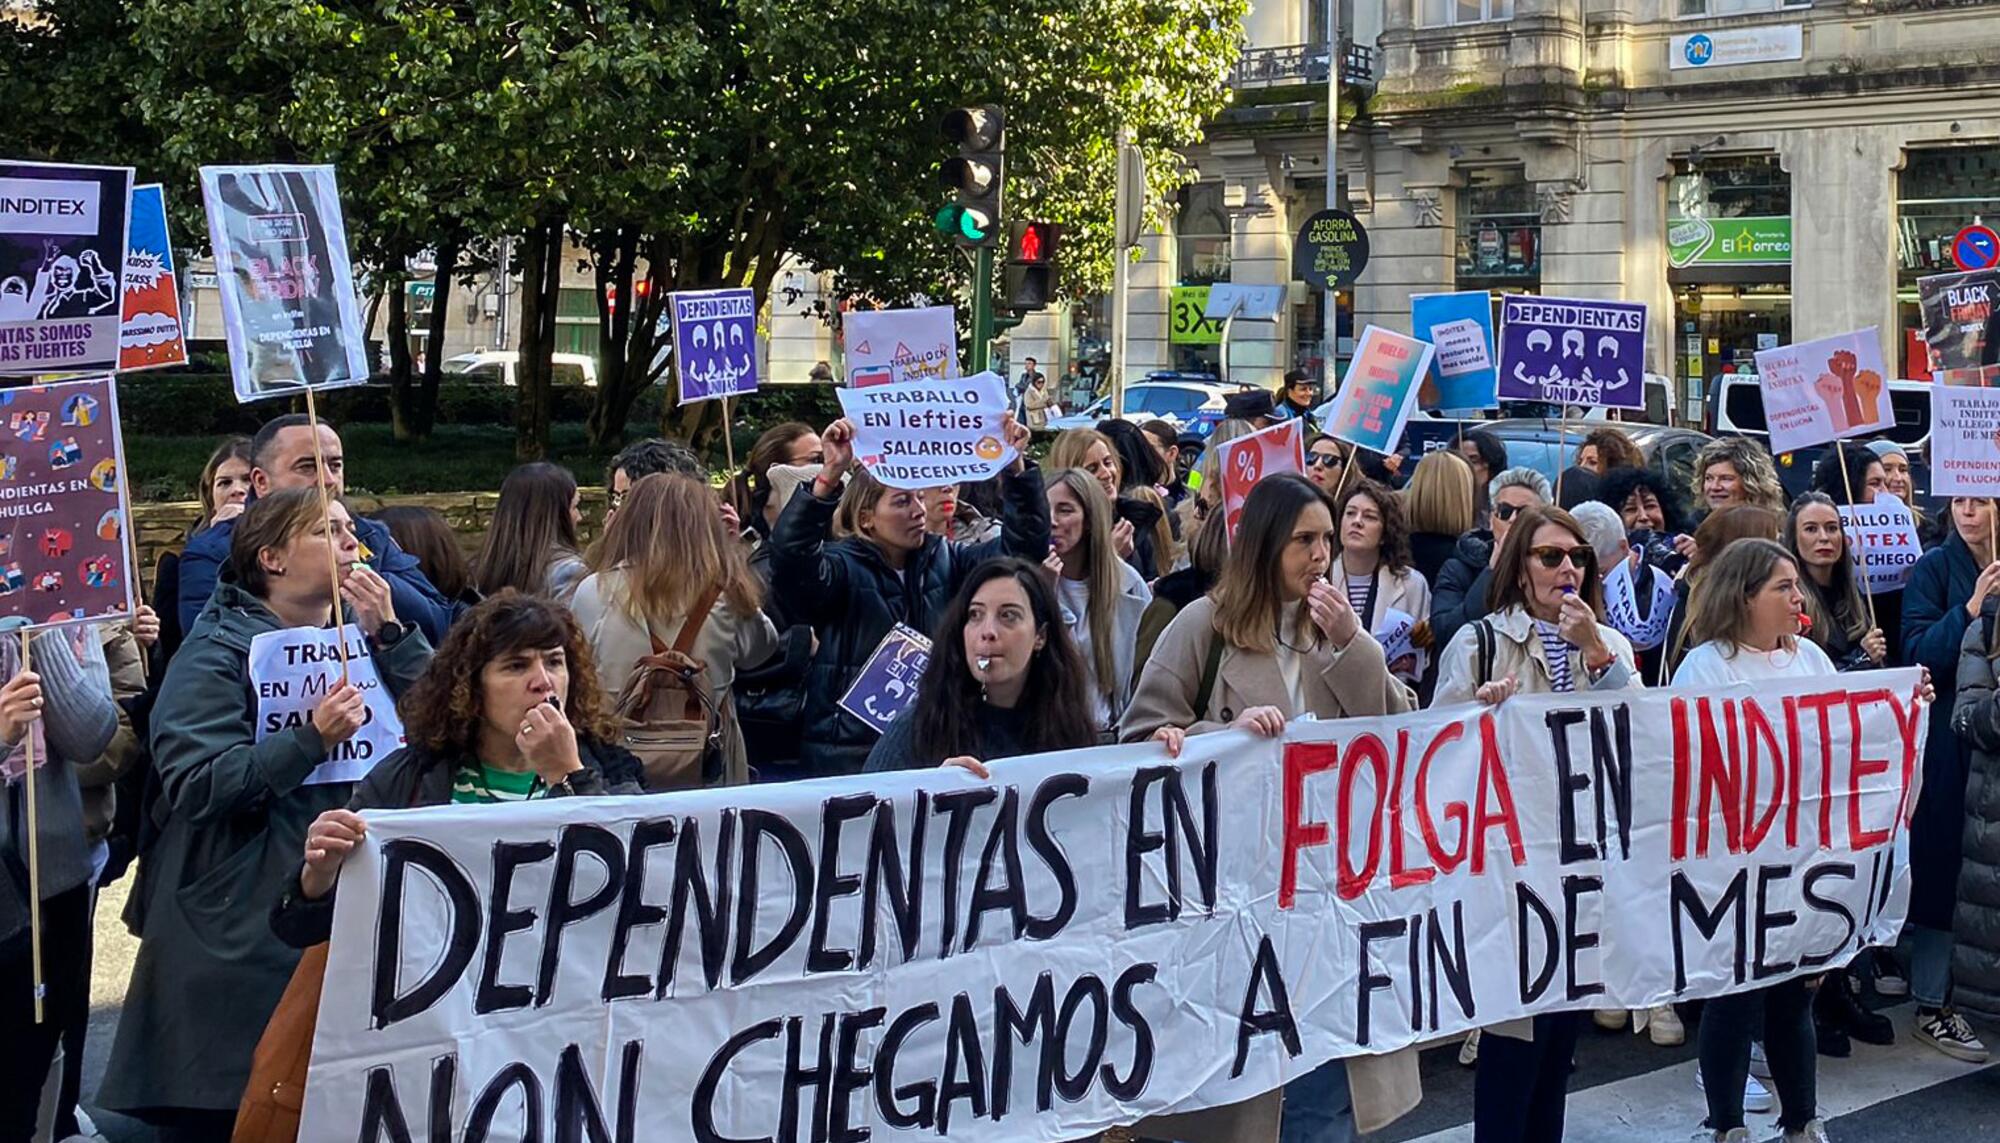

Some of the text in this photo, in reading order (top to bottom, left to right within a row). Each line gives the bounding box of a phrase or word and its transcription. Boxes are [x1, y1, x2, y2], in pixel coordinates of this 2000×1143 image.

[0, 198, 85, 215] INDITEX
[1313, 219, 1352, 230] AFORRA
[1308, 230, 1357, 243] GASOLINA
[1722, 239, 1734, 252] El
[248, 254, 320, 279] BLACK
[1947, 285, 1990, 306] BLACK
[681, 299, 752, 319] DEPENDIENTAS
[1509, 305, 1640, 329] DEPENDIENTAS
[1950, 302, 1991, 322] FRIDAY
[40, 323, 92, 341] SOMOS
[25, 341, 86, 360] FUERTES
[865, 390, 979, 404] TRABALLO
[1543, 387, 1600, 402] UNIDAS
[1951, 399, 1999, 408] TRABAJO
[863, 409, 983, 429] EN lefties
[1958, 419, 1993, 428] LLEGO
[1963, 430, 1977, 439] DE
[883, 440, 973, 456] SALARIOS
[875, 462, 991, 479] INDECENTES
[70, 479, 88, 491] EN
[1956, 475, 1969, 483] EN
[1893, 514, 1910, 526] EN
[1865, 553, 1916, 566] CHEGO
[260, 681, 289, 698] EN
[370, 773, 1090, 1029] DEPENDENTAS
[1124, 760, 1221, 930] EN
[1278, 712, 1527, 911] FOLGA
[1545, 702, 1631, 865] EN
[357, 1039, 644, 1143] NON
[691, 963, 1157, 1143] CHEGAMOS
[1231, 934, 1303, 1079] A
[1356, 900, 1476, 1046] FIN
[1515, 875, 1605, 1004] DE
